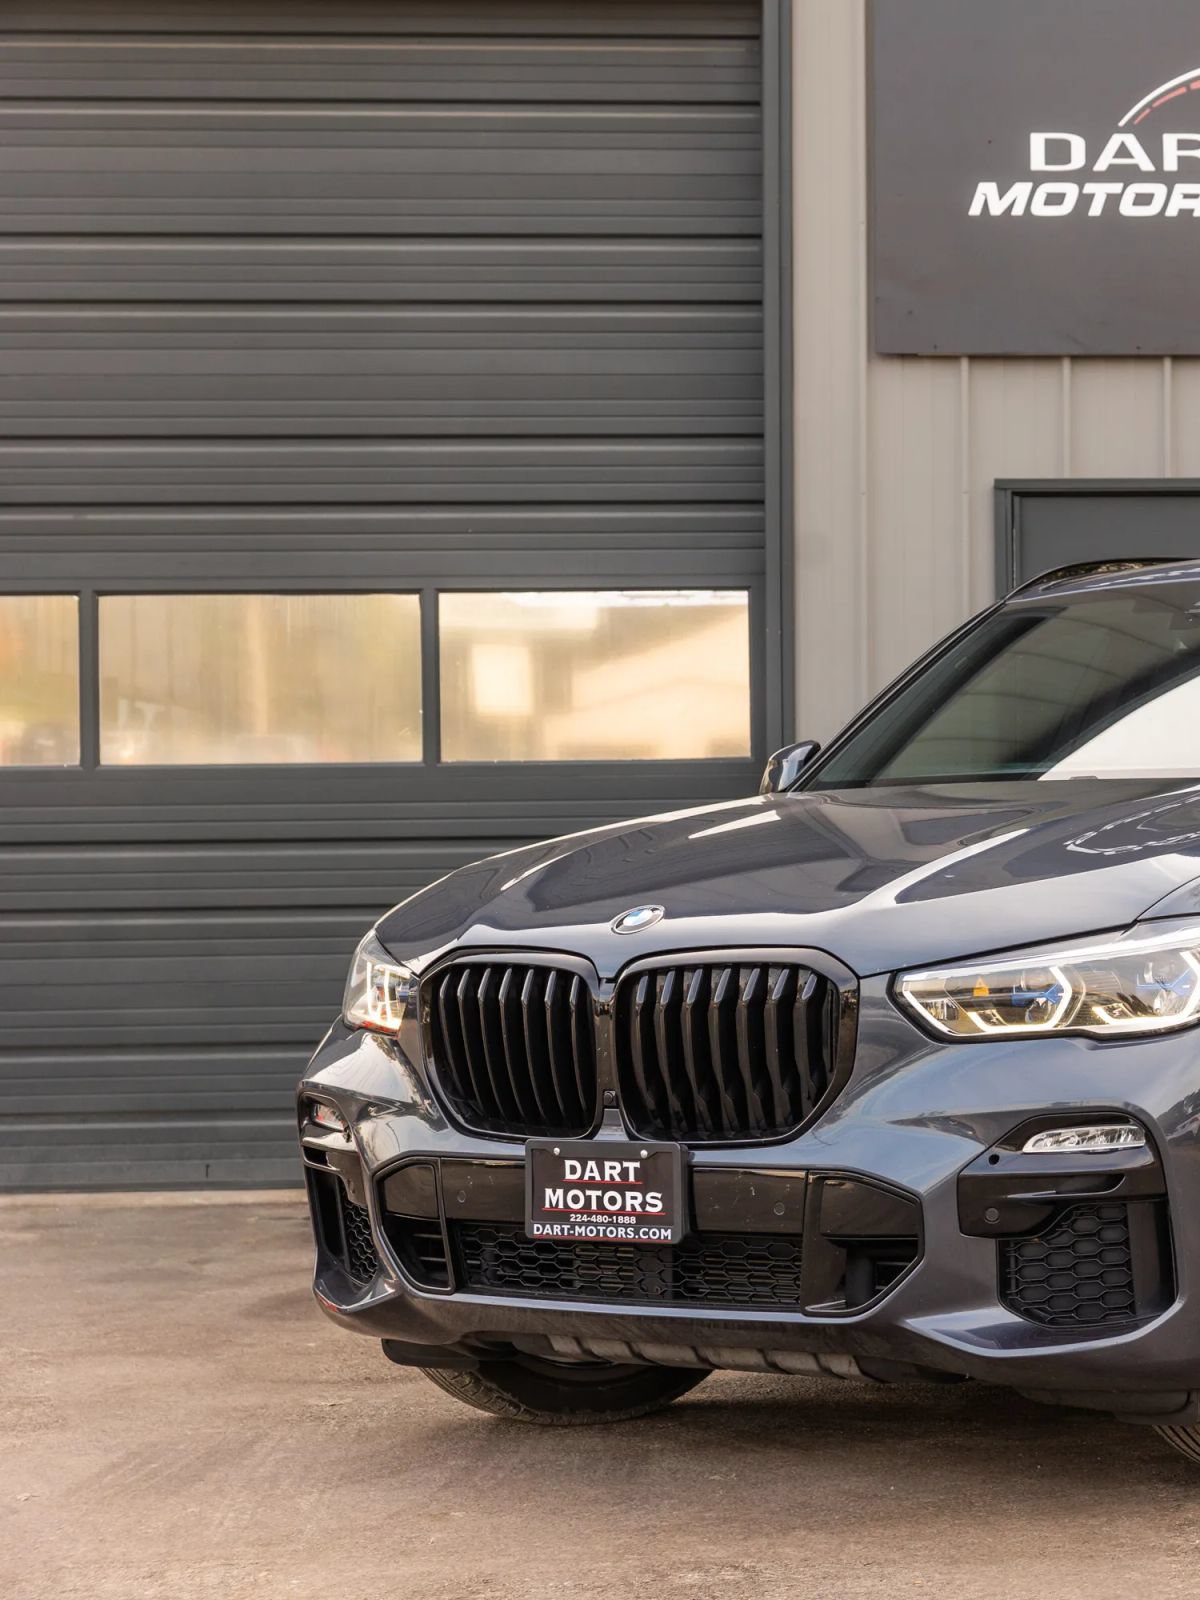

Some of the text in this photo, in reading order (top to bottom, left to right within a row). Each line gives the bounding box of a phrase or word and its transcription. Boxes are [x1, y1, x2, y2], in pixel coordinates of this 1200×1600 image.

[564, 1160, 641, 1182] DART
[544, 1188, 663, 1213] MOTORS
[569, 1213, 637, 1225] 224-480-1888
[533, 1223, 672, 1241] DART-MOTORS.COM
